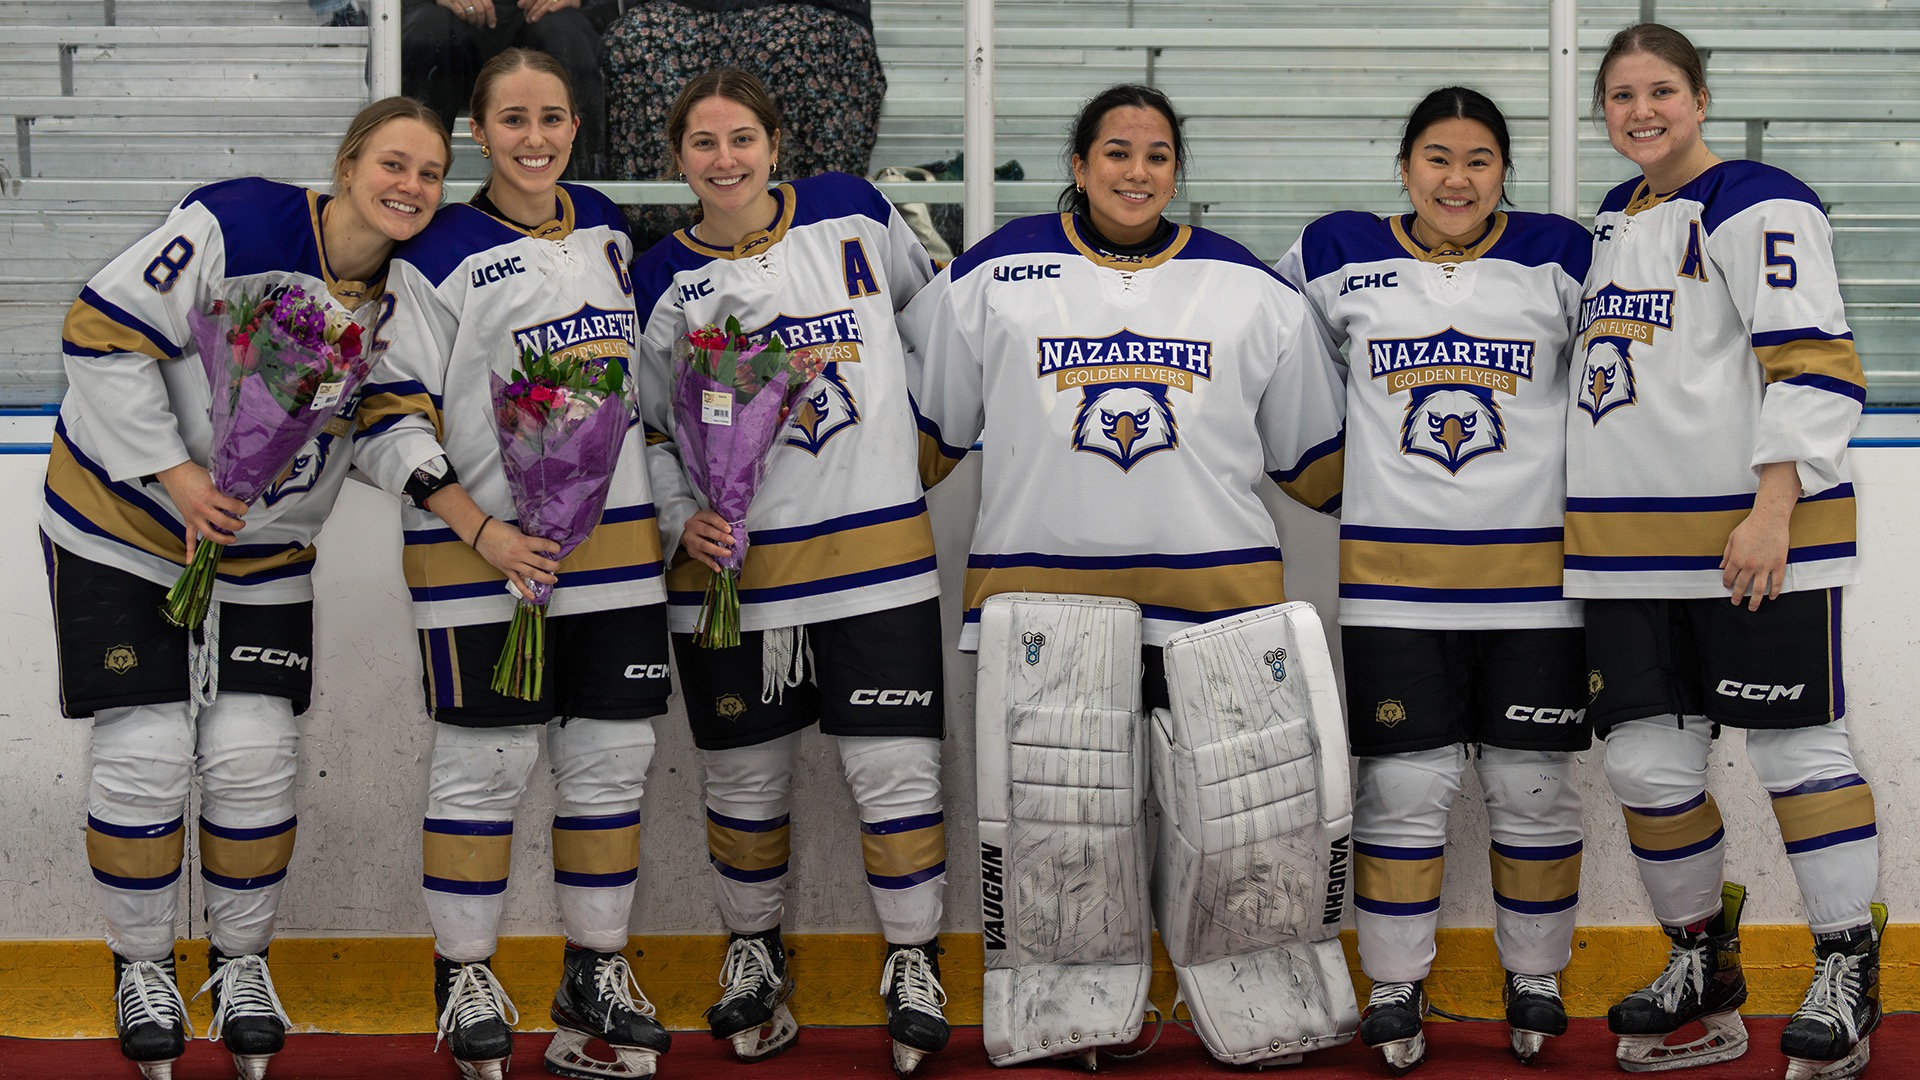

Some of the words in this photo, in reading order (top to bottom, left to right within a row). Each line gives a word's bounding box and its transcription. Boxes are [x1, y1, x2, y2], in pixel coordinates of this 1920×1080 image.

[142, 234, 196, 294] 8
[1677, 219, 1709, 282] A
[1763, 230, 1798, 290] 5
[471, 255, 526, 288] UCHC
[603, 239, 632, 298] C
[840, 237, 881, 299] A
[993, 263, 1061, 282] UCHC
[673, 278, 715, 311] HC
[1578, 293, 1670, 332] NAARETH
[517, 313, 635, 361] NAZARETH
[747, 312, 863, 350] ARETH
[1608, 321, 1648, 340] FLYERS
[603, 341, 629, 355] FLYE
[809, 345, 853, 361] YERS
[1041, 340, 1208, 375] NAZARETH
[1371, 341, 1532, 376] NAZARETH
[1064, 367, 1130, 386] GOLDEN
[1133, 366, 1186, 387] FLYERS
[1394, 368, 1456, 389] GOLDEN
[1459, 368, 1510, 390] FLYERS
[230, 645, 309, 672] CCM
[623, 663, 670, 679] CCM
[849, 689, 934, 707] CCM
[1715, 679, 1806, 702] CCM
[1504, 704, 1588, 725] CCM
[980, 842, 1008, 951] VAUGHN
[1321, 834, 1351, 926] VAUGHN
